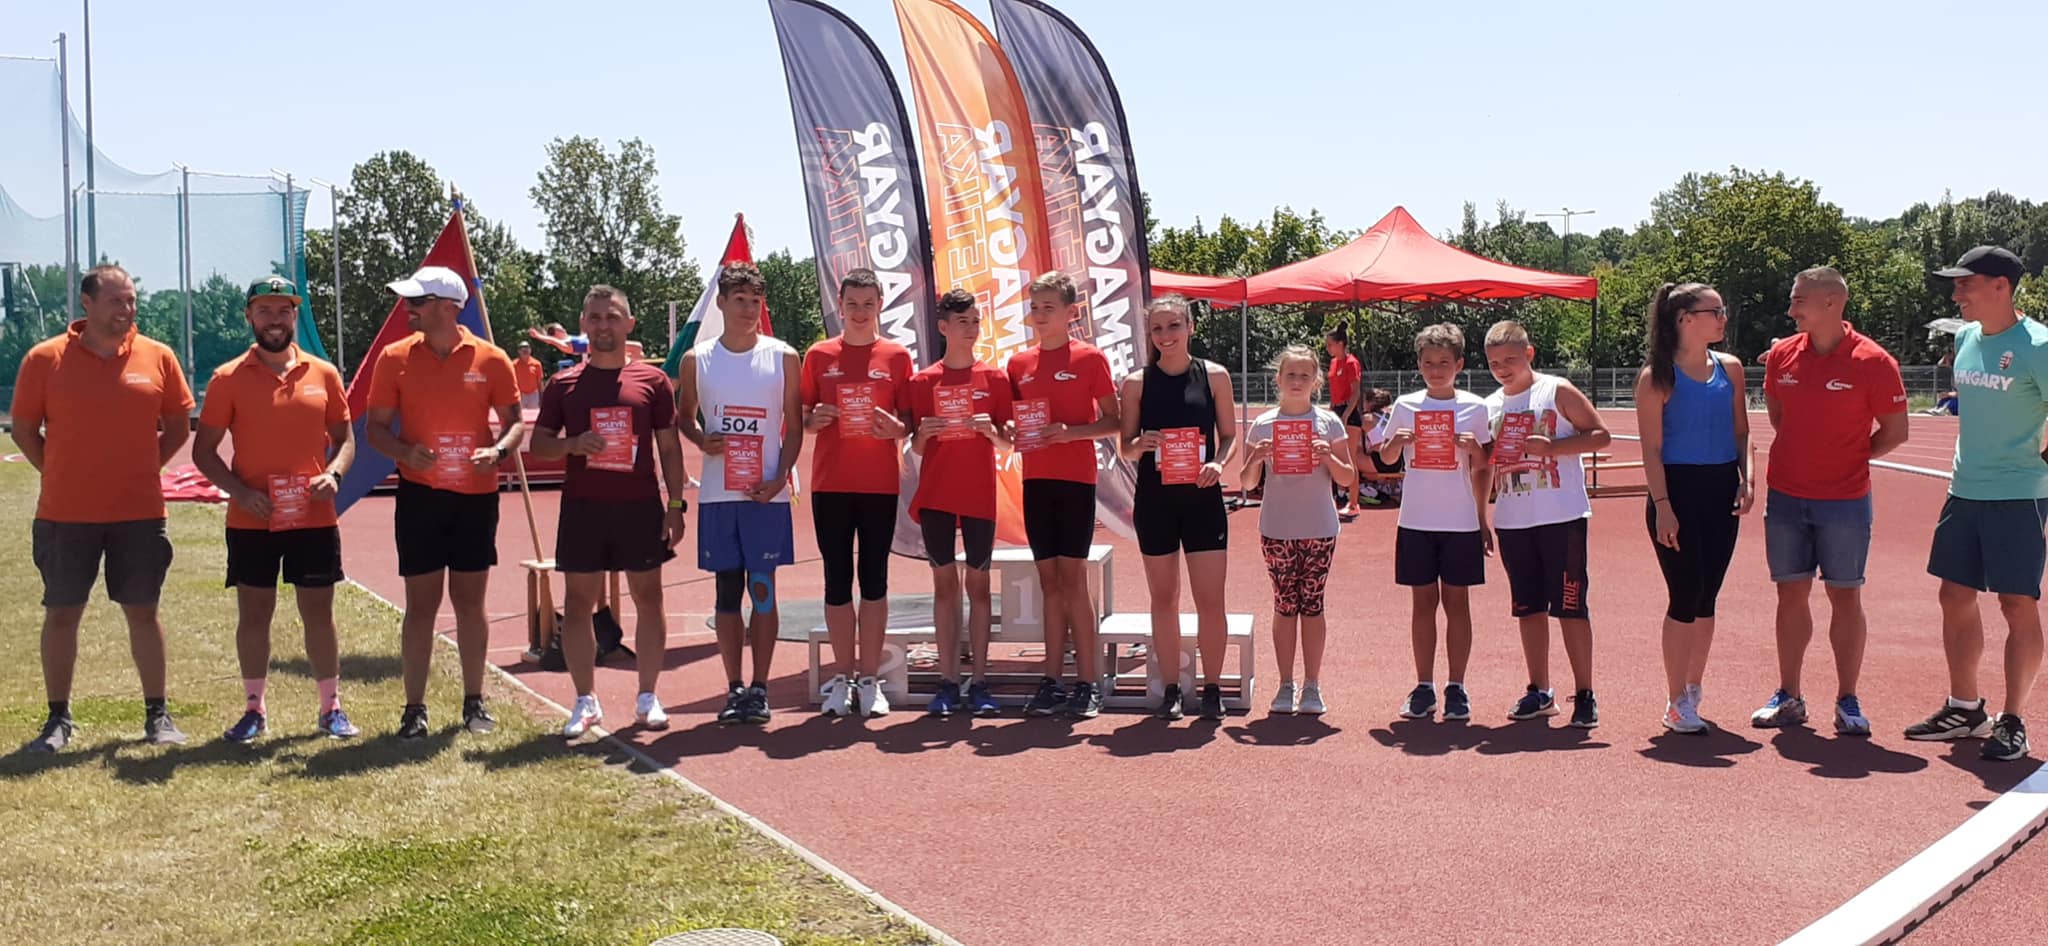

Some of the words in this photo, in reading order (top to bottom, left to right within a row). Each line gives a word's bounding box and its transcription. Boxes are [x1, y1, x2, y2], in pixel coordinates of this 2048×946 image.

[721, 417, 759, 433] 504
[1010, 576, 1039, 625] 1
[1563, 571, 1579, 610] TRUE
